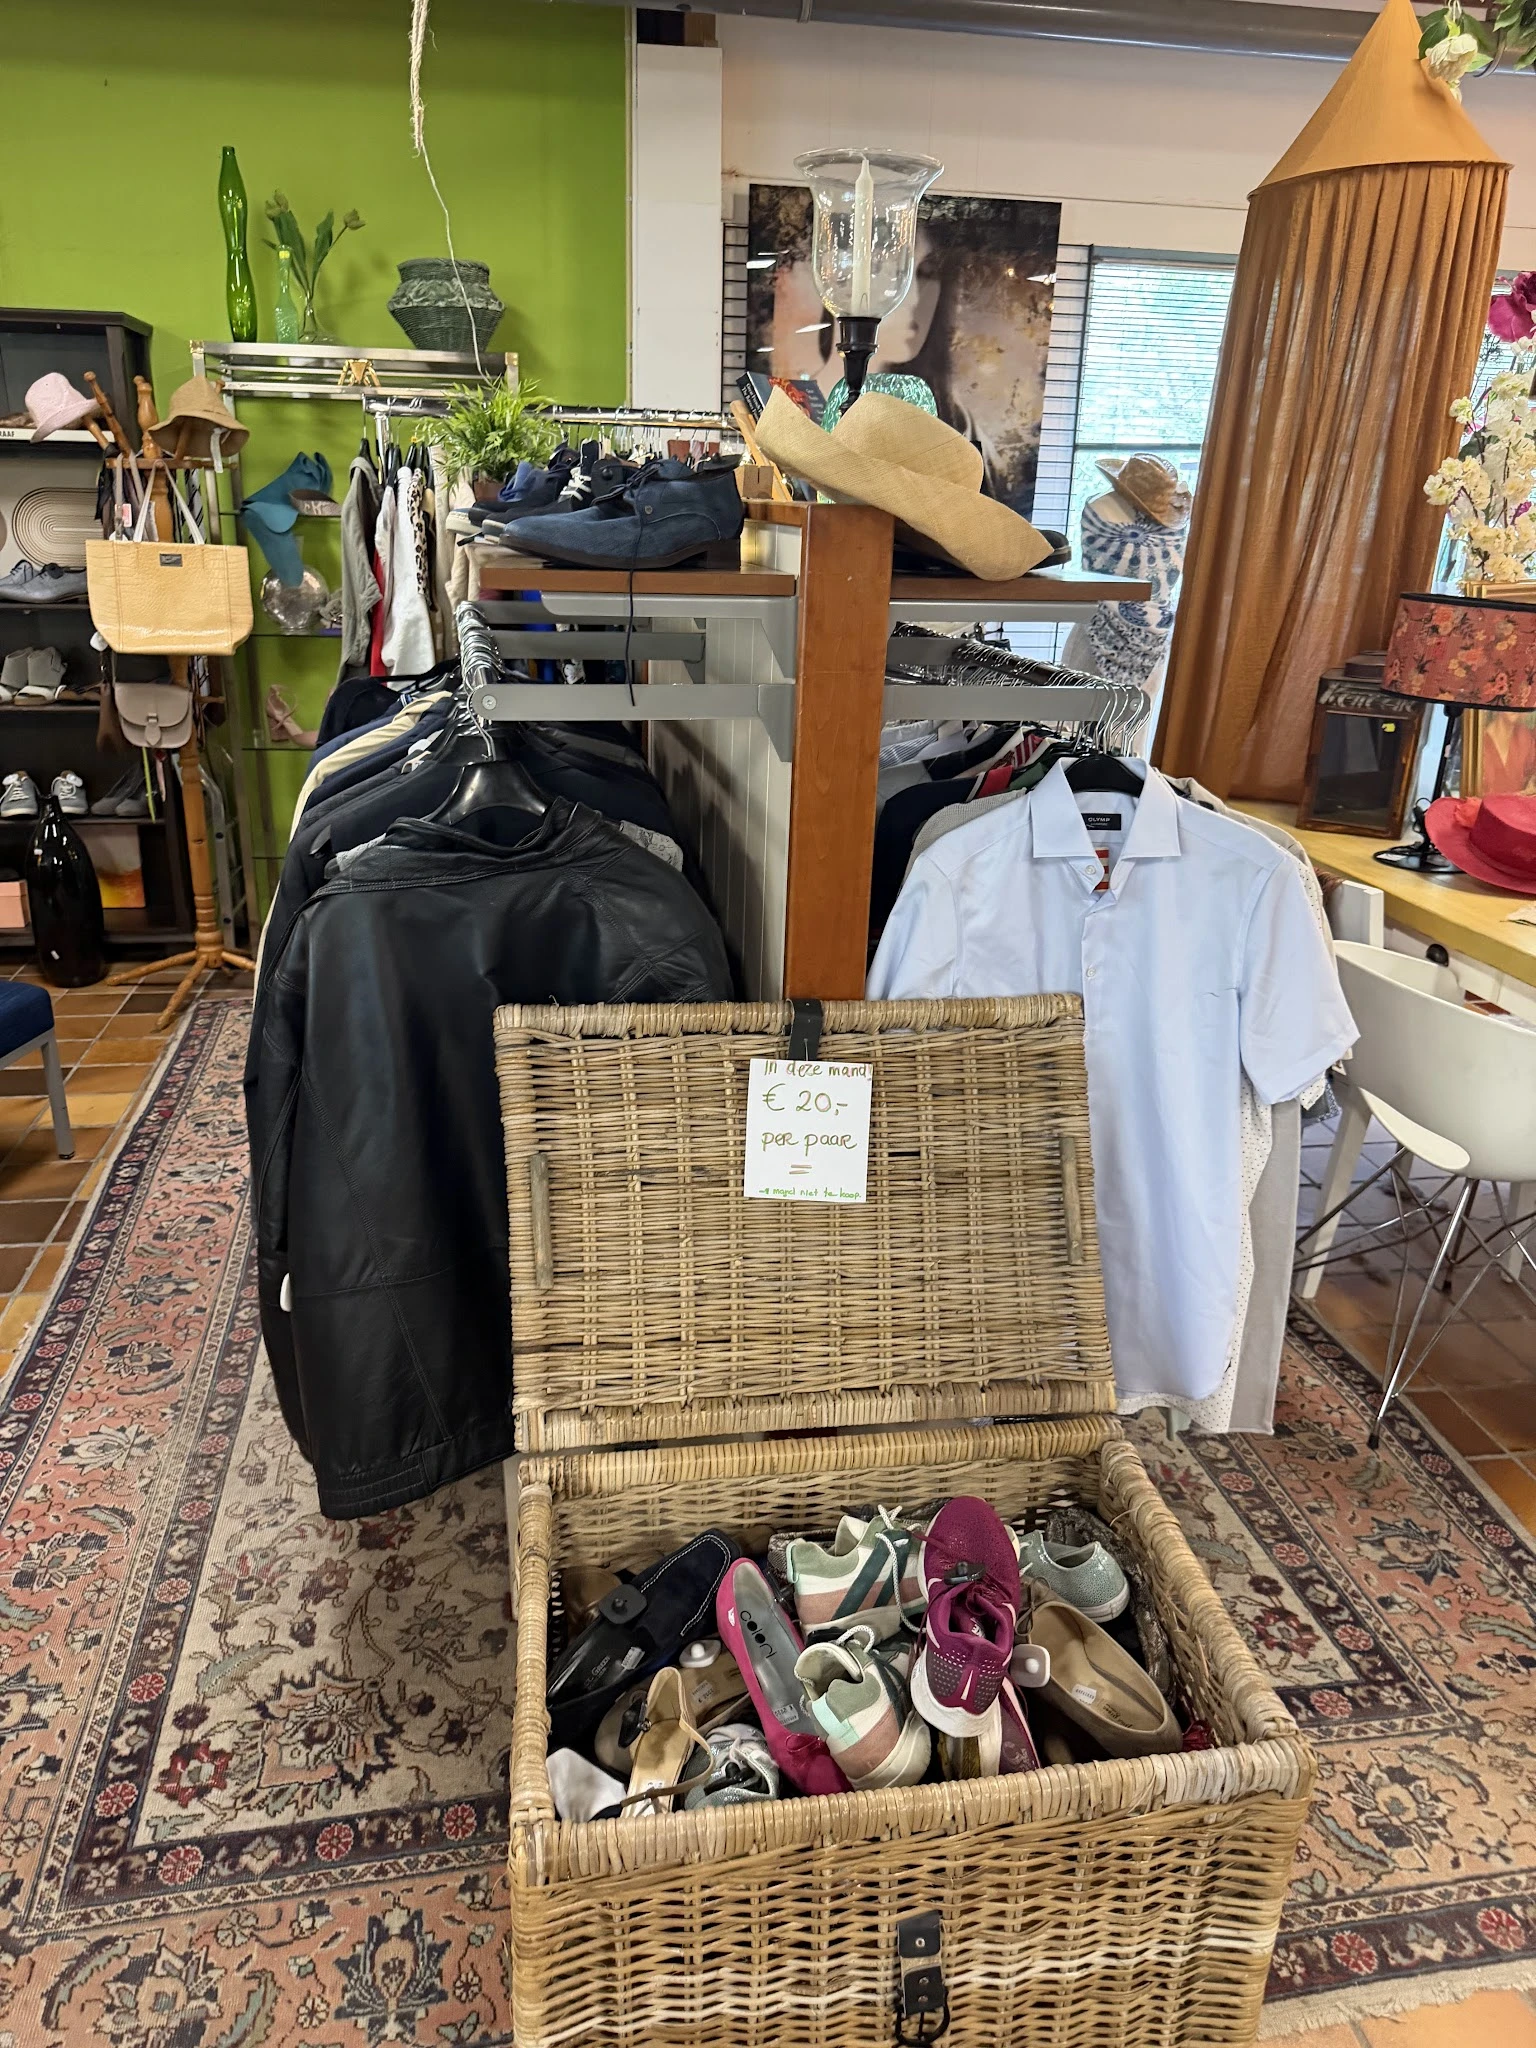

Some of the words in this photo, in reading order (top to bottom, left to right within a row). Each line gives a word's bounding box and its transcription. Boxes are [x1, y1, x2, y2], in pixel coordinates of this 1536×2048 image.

[764, 1060, 778, 1076] In
[786, 1060, 823, 1078] deze
[762, 1083, 786, 1111] €
